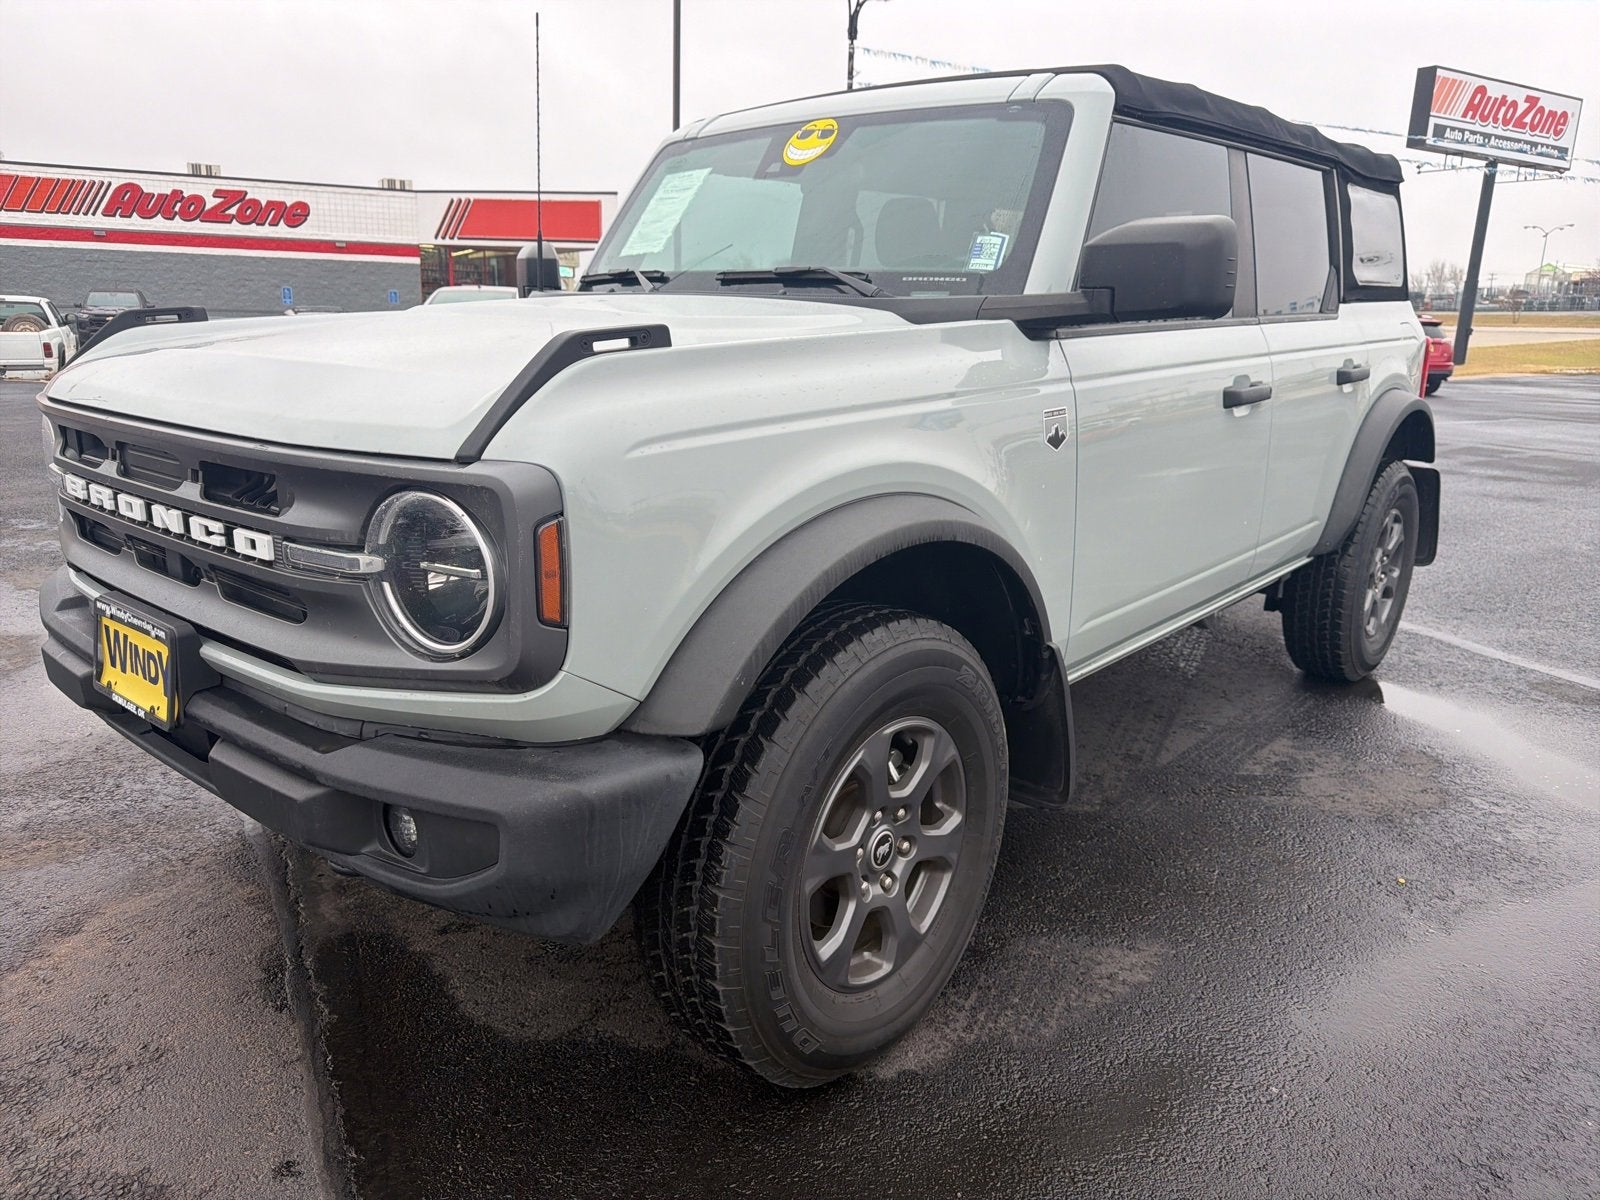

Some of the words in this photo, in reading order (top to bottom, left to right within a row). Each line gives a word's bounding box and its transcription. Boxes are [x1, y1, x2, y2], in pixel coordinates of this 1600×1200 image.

[1444, 127, 1463, 140] Auto
[1464, 131, 1484, 144] Parts
[1460, 84, 1570, 138] AutoZone
[102, 181, 311, 228] AutoZone
[64, 472, 275, 562] BRONCO
[103, 623, 169, 698] WINDY
